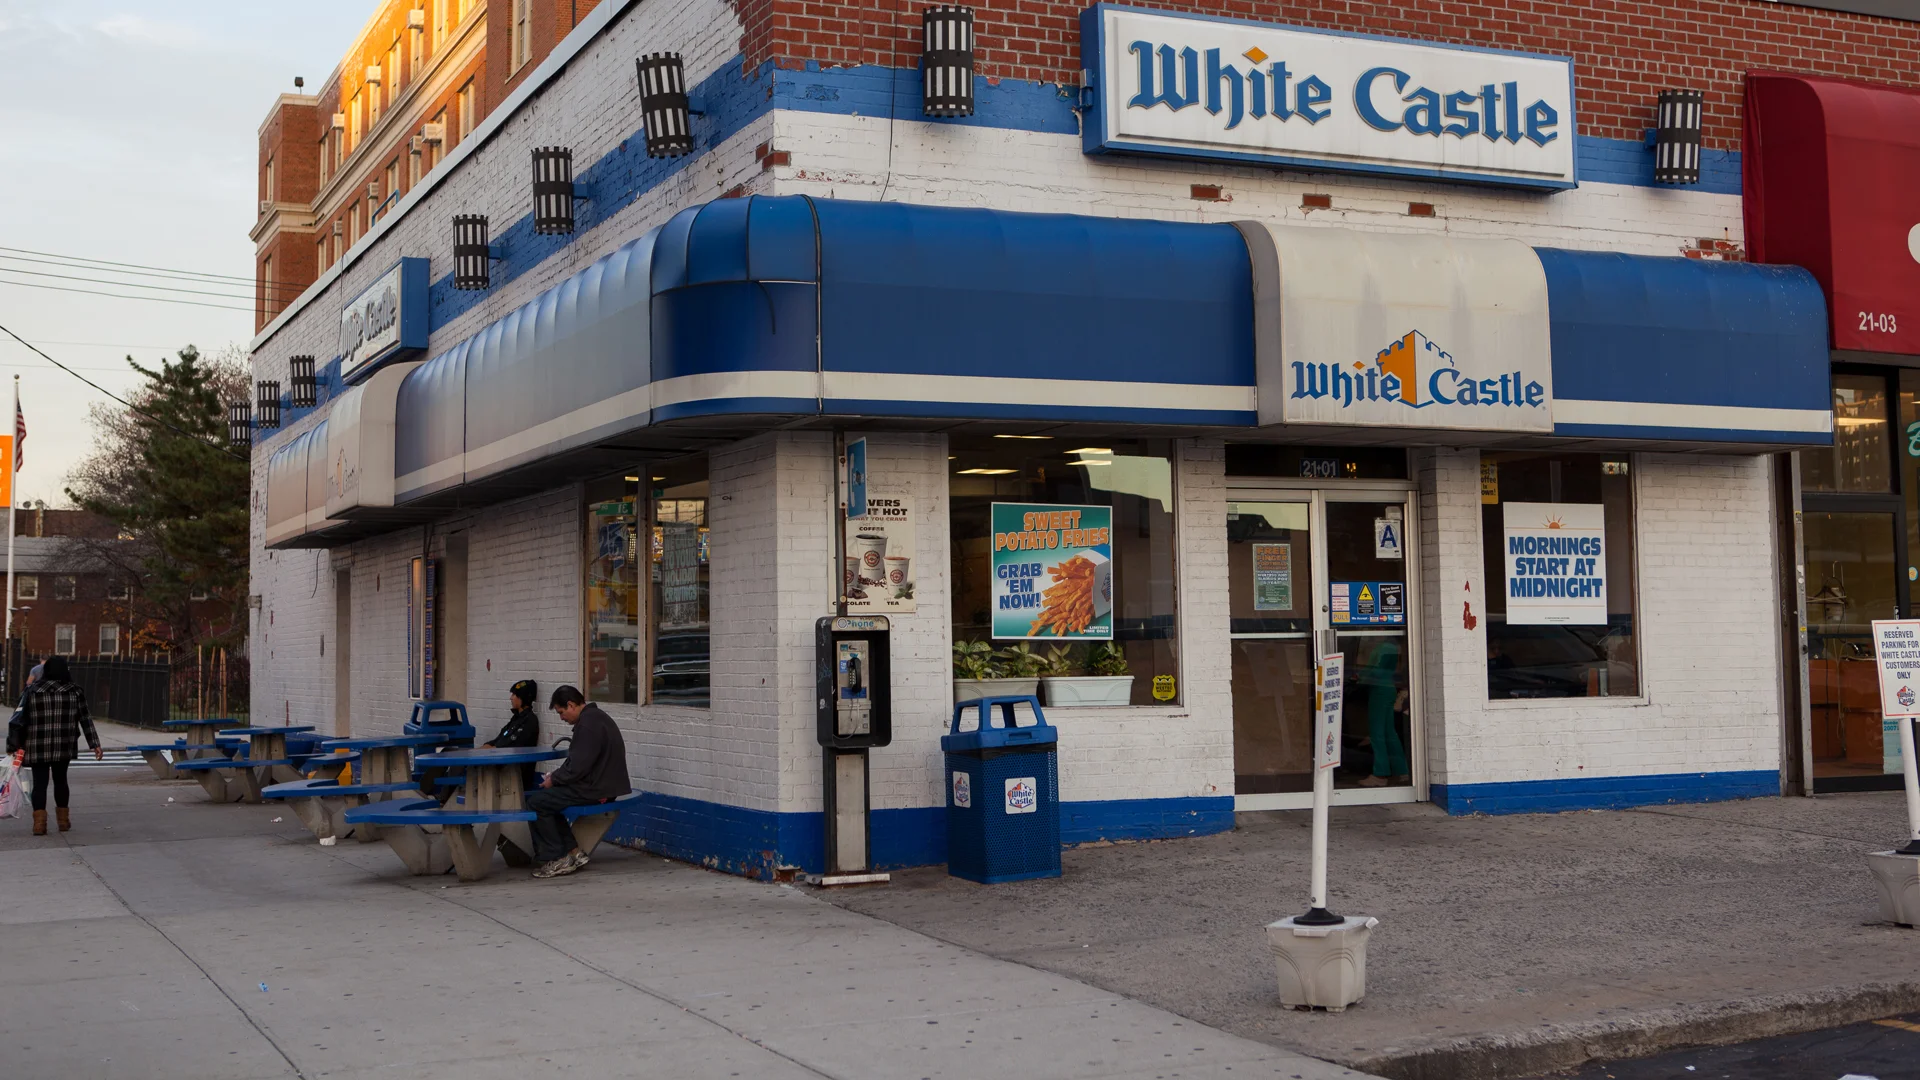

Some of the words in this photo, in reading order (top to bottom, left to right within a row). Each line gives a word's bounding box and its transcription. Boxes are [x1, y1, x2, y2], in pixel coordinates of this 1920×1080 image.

[1128, 40, 1331, 130] White
[1353, 67, 1558, 147] Castle
[1858, 312, 1896, 333] 21-03
[1291, 361, 1400, 408] White
[1429, 368, 1544, 408] Castle
[1024, 510, 1081, 531] SWEET
[995, 530, 1058, 551] POTATO
[1062, 527, 1109, 548] FRIES
[1380, 525, 1397, 547] A
[1509, 536, 1601, 555] MORNINGS
[676, 548, 697, 568] YOUR
[1515, 557, 1569, 575] START
[1574, 558, 1595, 575] AT
[666, 567, 696, 586] HOLIDAY
[997, 563, 1042, 578] GRAB
[665, 585, 696, 603] CRAVINGS
[1006, 579, 1034, 593] 'EM
[1510, 577, 1603, 598] MIDNIGHT
[1000, 593, 1041, 610] NOW!
[1886, 661, 1920, 669] CUSTOMERS
